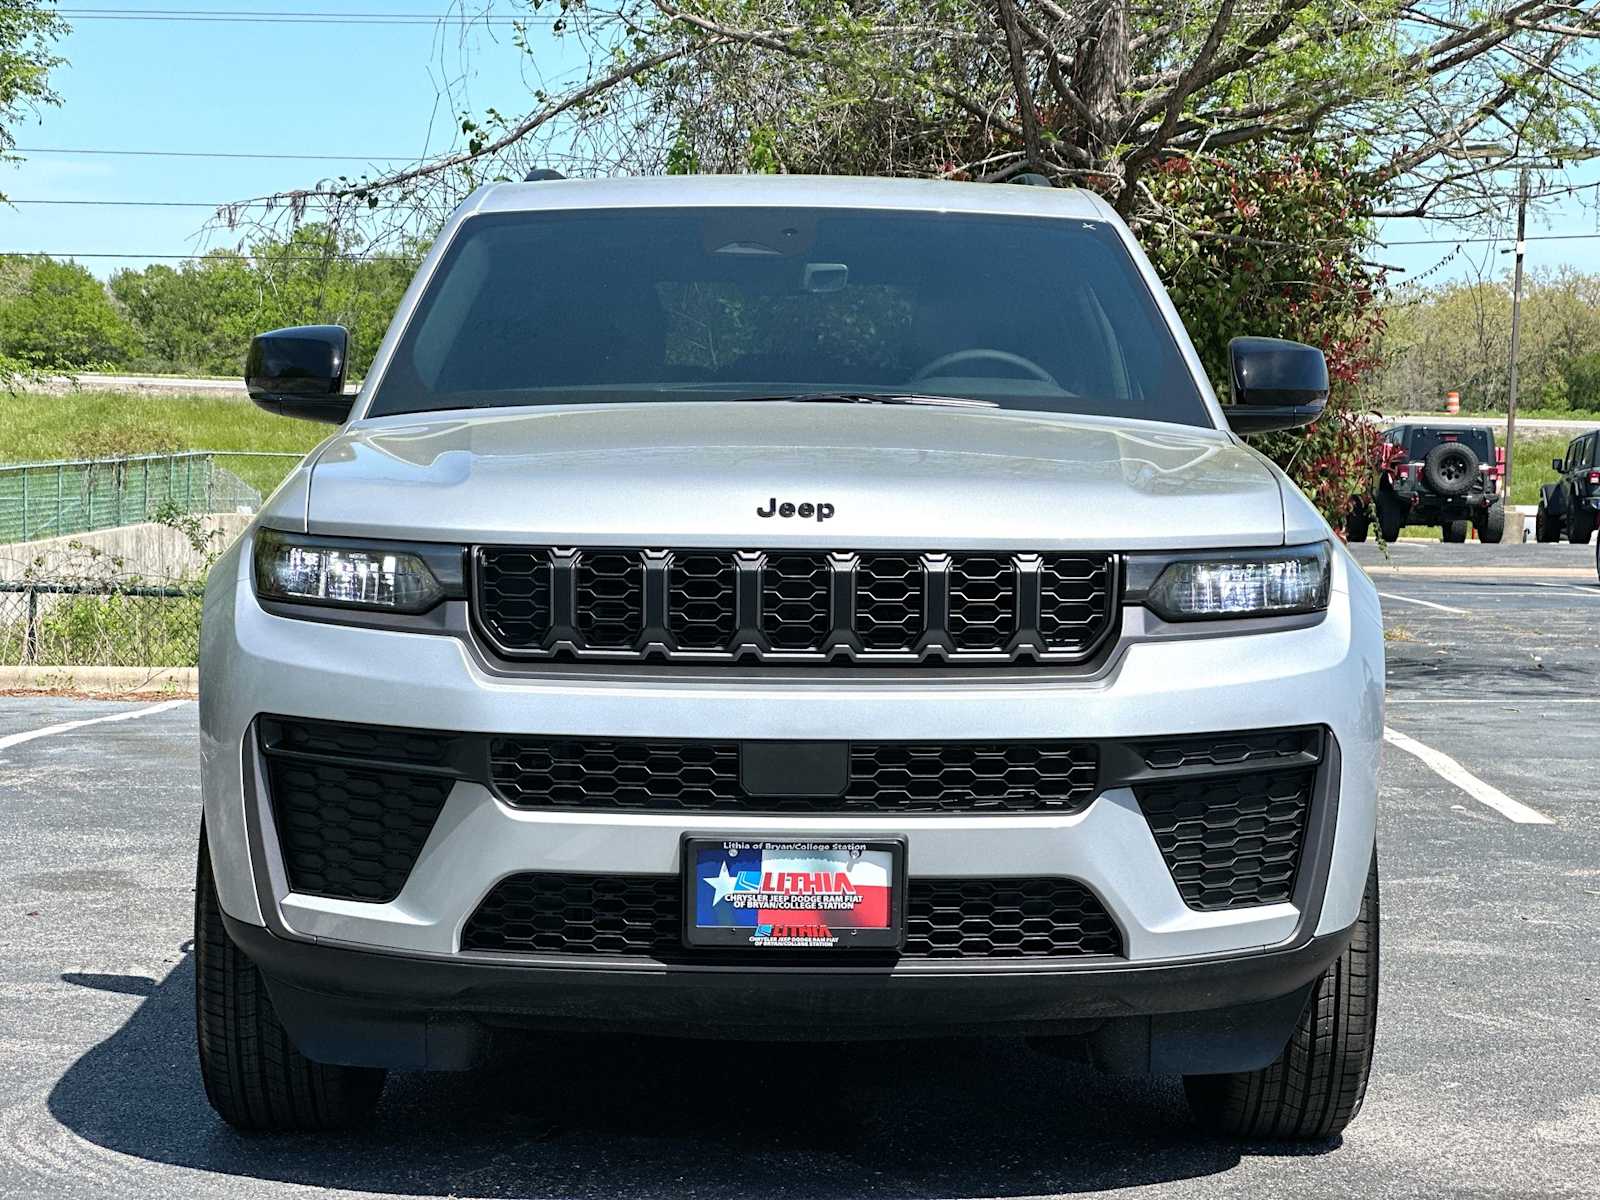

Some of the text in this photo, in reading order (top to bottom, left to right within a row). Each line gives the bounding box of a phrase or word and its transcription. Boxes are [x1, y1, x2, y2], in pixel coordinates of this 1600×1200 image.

[757, 498, 835, 522] Jeep
[723, 842, 751, 850] Lithia
[752, 842, 763, 850] of
[832, 843, 866, 851] Station
[762, 872, 857, 893] LITHIA
[724, 894, 769, 902] CHRYSLER
[791, 895, 822, 903] DODGE
[823, 895, 844, 903] RAM
[845, 895, 864, 903] FIAT
[747, 901, 817, 909] BRYAN/COLLEGE
[772, 925, 833, 937] LITHIA
